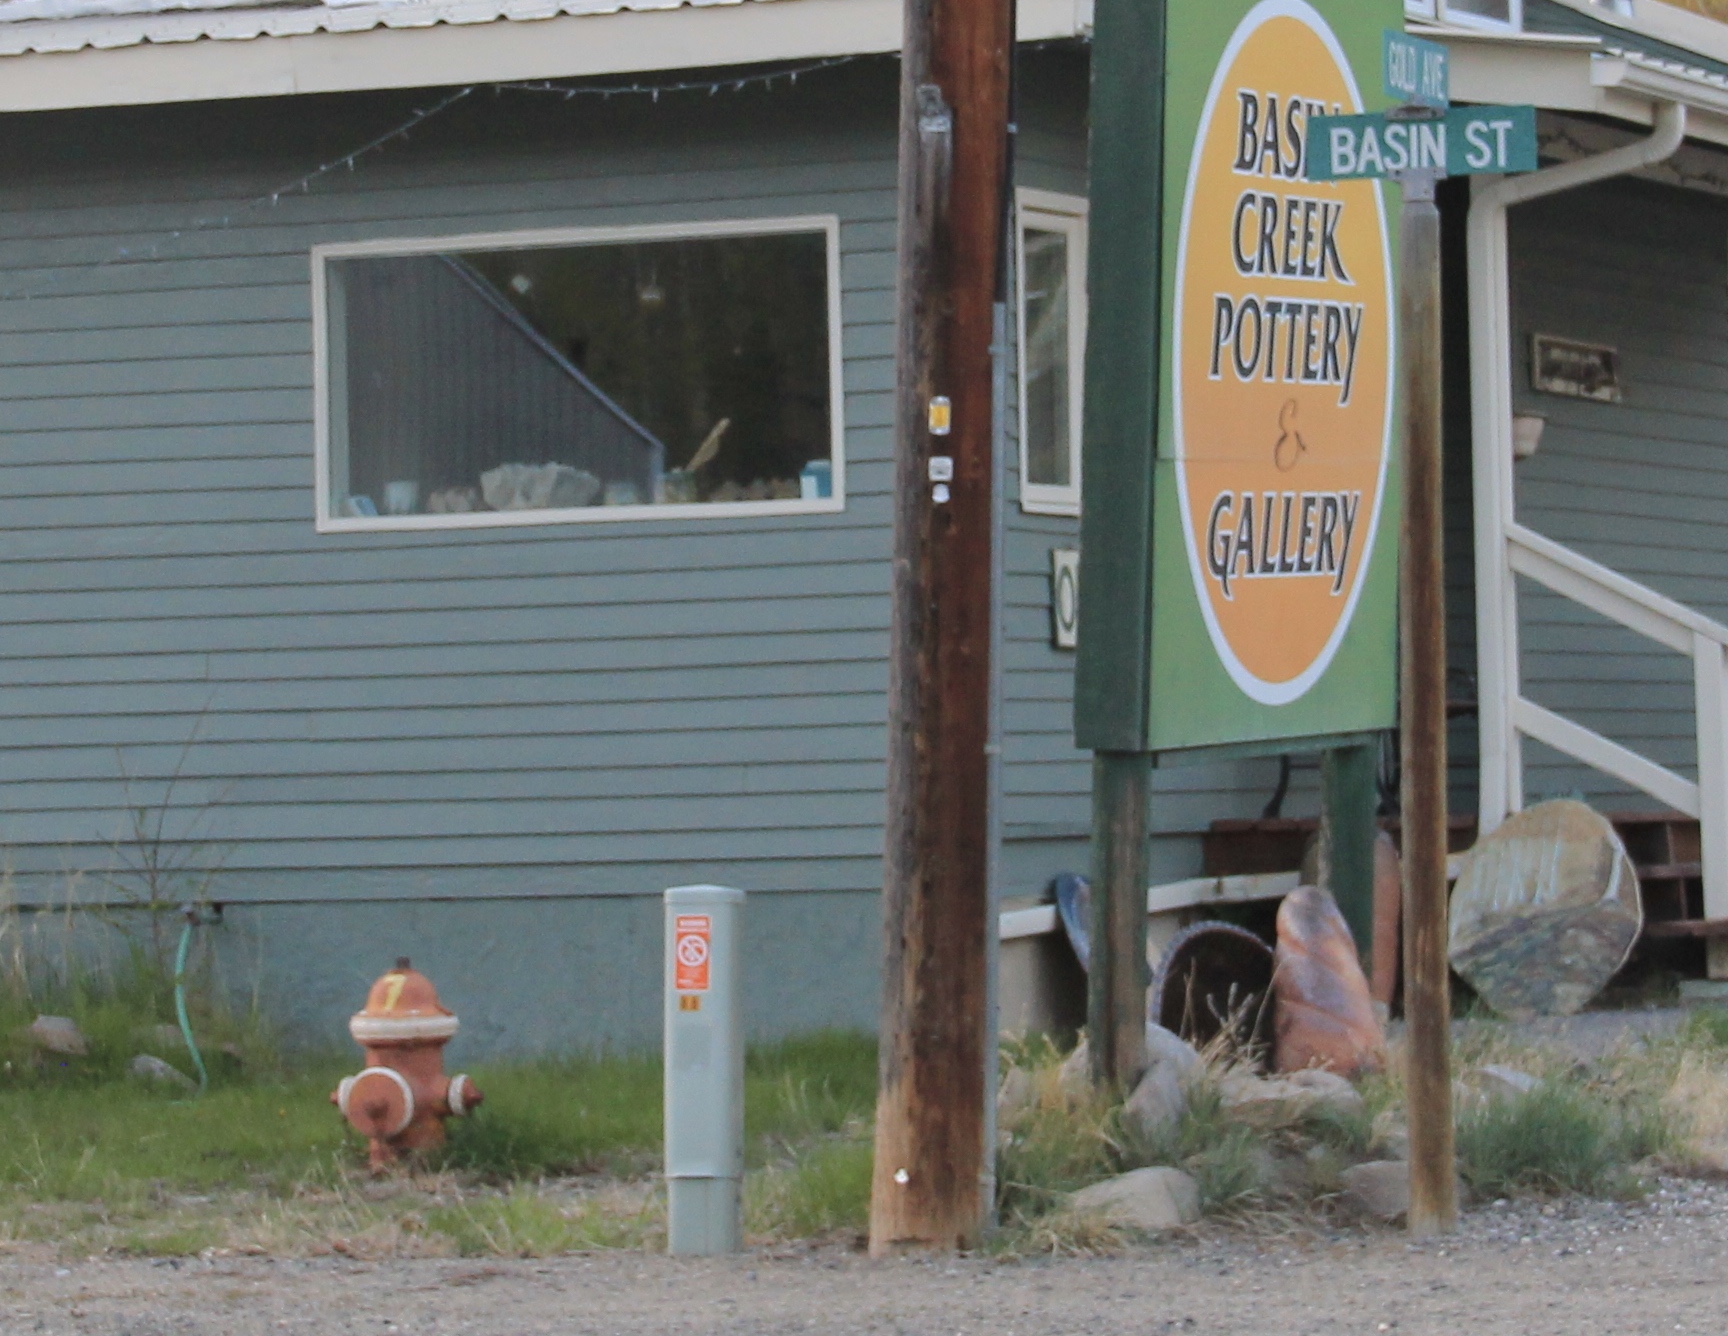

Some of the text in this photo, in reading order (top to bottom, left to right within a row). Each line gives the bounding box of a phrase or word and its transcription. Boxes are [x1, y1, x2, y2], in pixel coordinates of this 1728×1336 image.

[1388, 42, 1444, 100] GOLD AVE
[1233, 89, 1341, 184] BAS
[1330, 120, 1514, 175] BASIN ST
[1232, 189, 1355, 285] CREEK
[1208, 292, 1365, 407] POTTERY
[1274, 398, 1306, 472] &
[1206, 490, 1362, 601] GALLERY
